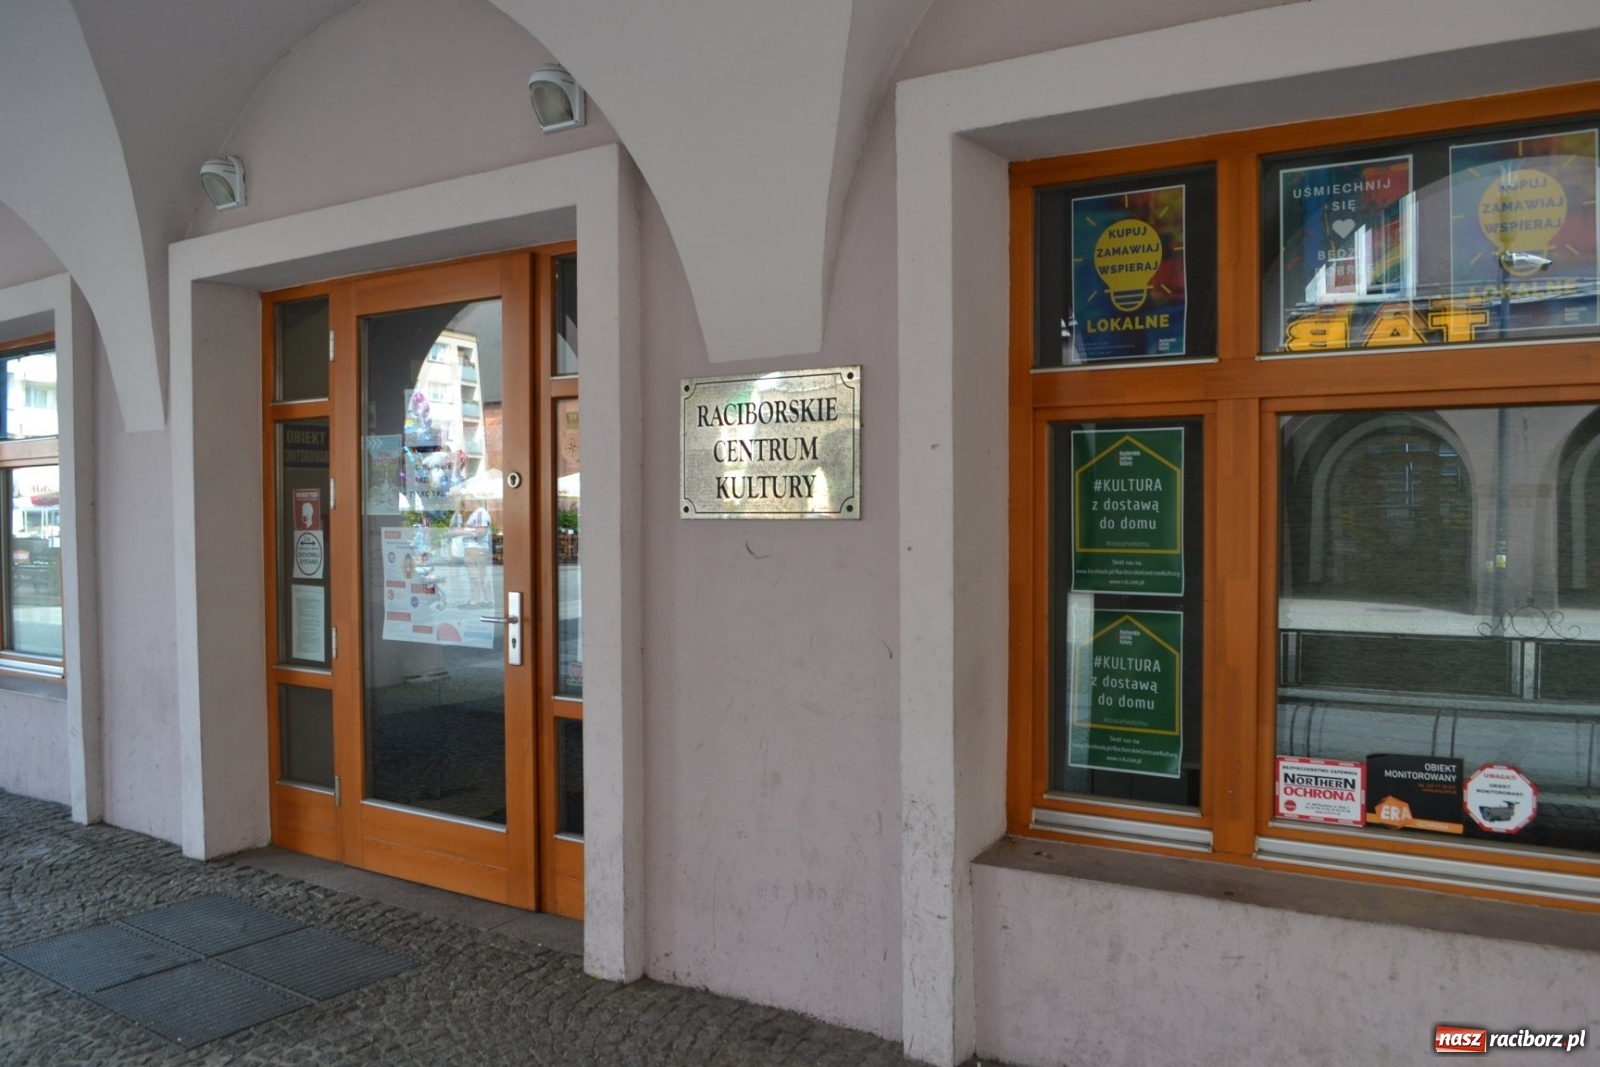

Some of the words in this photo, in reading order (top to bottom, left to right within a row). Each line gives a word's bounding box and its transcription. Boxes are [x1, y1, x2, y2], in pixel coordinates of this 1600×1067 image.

[1293, 178, 1391, 199] UŚMIECHNIJ
[1332, 199, 1356, 212] SIĘ
[1481, 196, 1564, 214] ZAMAWIAJ
[1109, 226, 1147, 239] KUPUJ
[1484, 217, 1561, 234] WSPIERAJ
[1096, 243, 1160, 258] ZAMAWIAJ
[1099, 261, 1158, 275] WSPIERAJ
[1087, 314, 1170, 334] LOKALNE
[697, 397, 839, 427] RACIBORSKIE
[286, 430, 327, 445] OBIEKT
[713, 436, 819, 463] CENTRUM
[716, 474, 817, 499] KULTURY
[1093, 478, 1163, 492] #KULTURA
[1092, 500, 1099, 511] z
[1103, 497, 1160, 513] dostawą
[1099, 516, 1115, 530] do
[1120, 516, 1157, 530] domu
[1094, 655, 1161, 673] #KULTURA
[1091, 676, 1098, 687] z
[1102, 674, 1158, 694] dostawą
[1098, 692, 1113, 706] do
[1118, 694, 1155, 710] domu
[1384, 769, 1457, 782] MONITOROWANY
[1424, 763, 1457, 773] OBIEKT
[1283, 786, 1356, 803] OCHRONA
[1381, 805, 1413, 820] ERA
